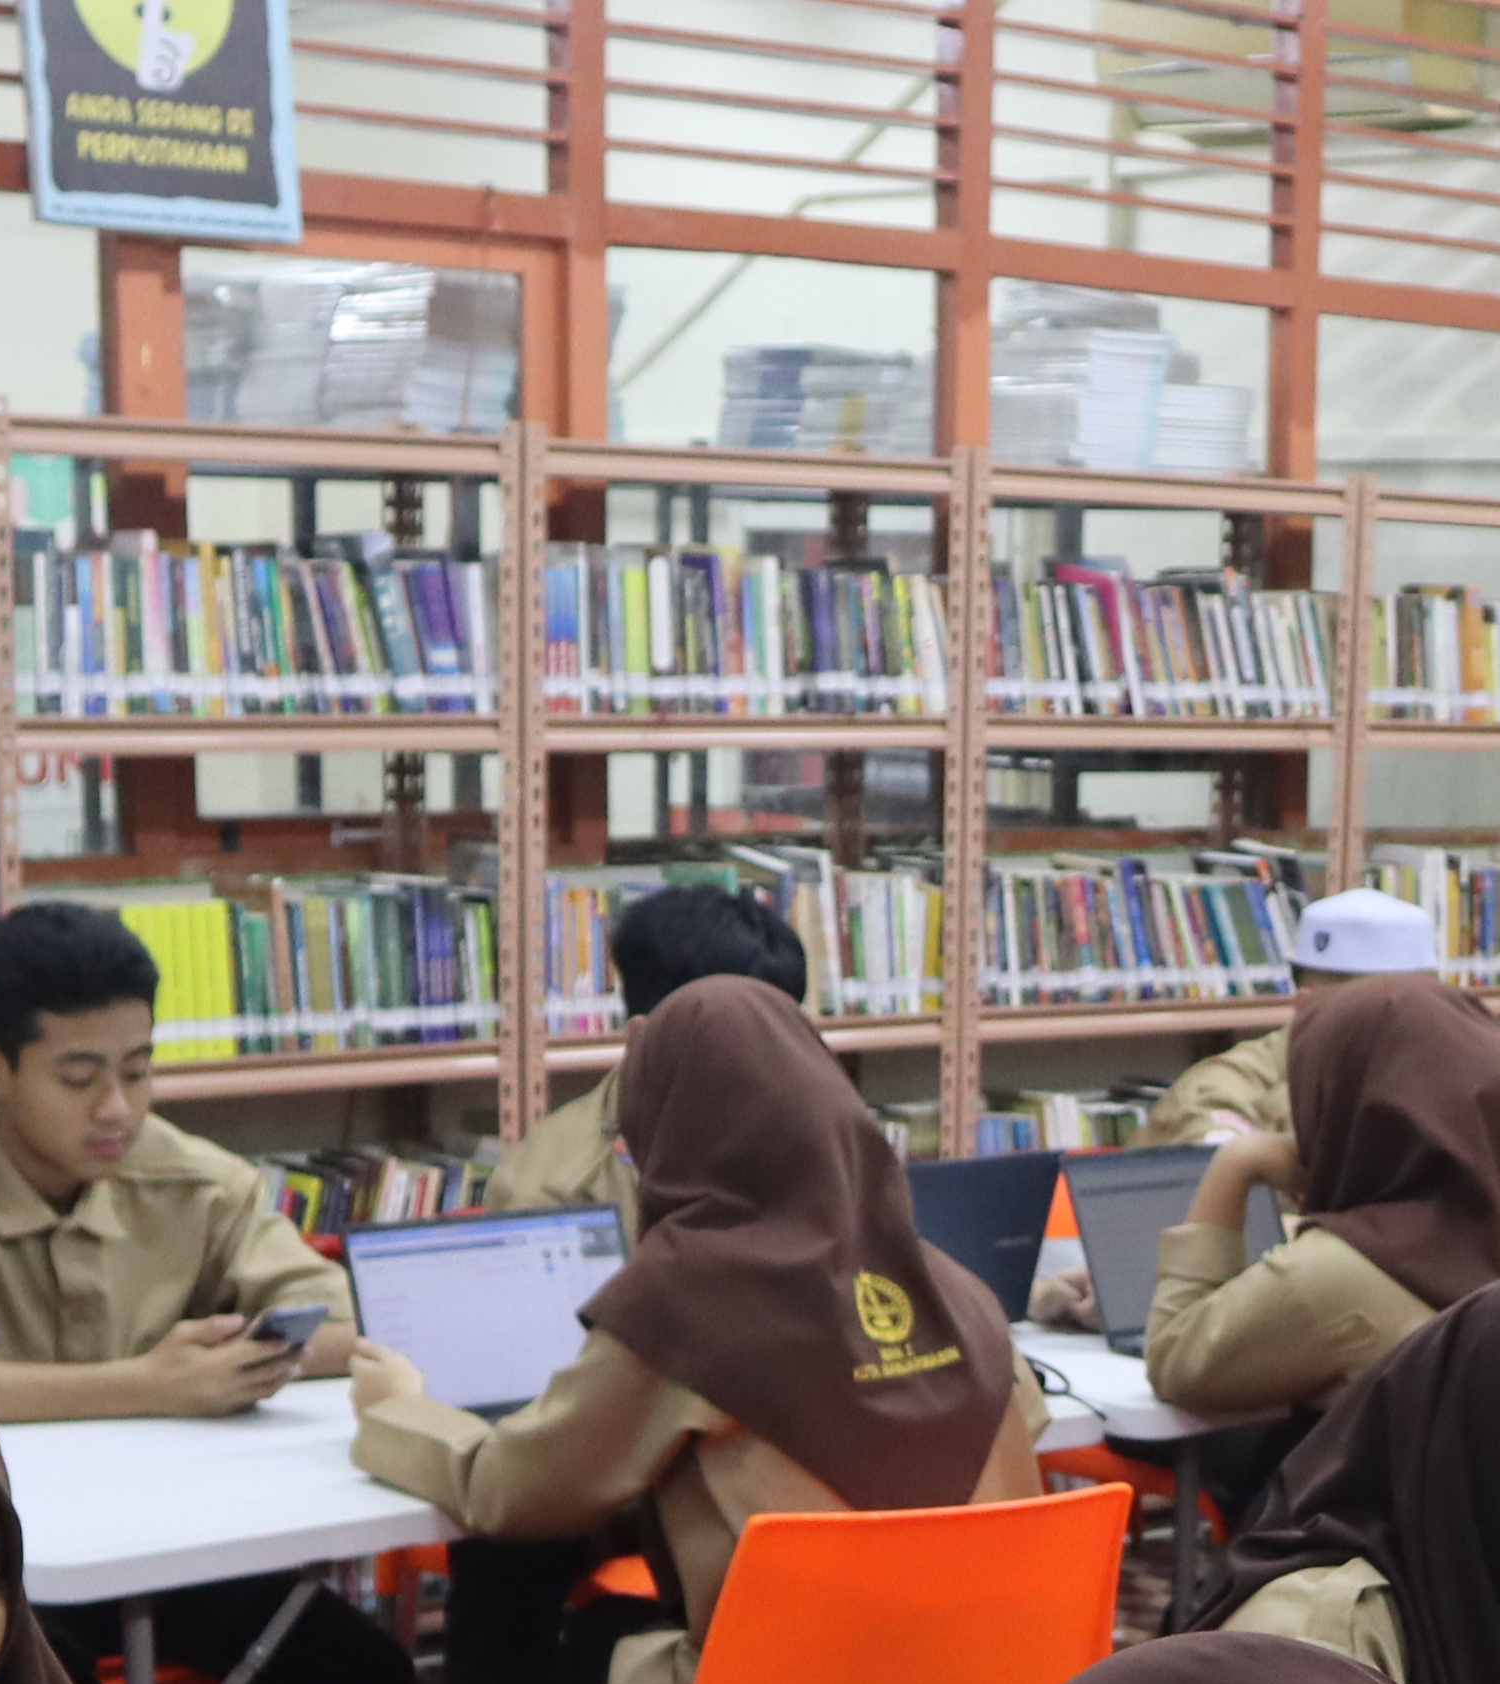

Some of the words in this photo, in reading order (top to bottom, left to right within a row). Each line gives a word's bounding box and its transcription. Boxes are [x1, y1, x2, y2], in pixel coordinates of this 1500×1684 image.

[65, 91, 133, 124] ANDA
[136, 97, 224, 134] SEDANG
[226, 107, 254, 138] DI
[77, 129, 248, 174] PERPUSTAKAAN
